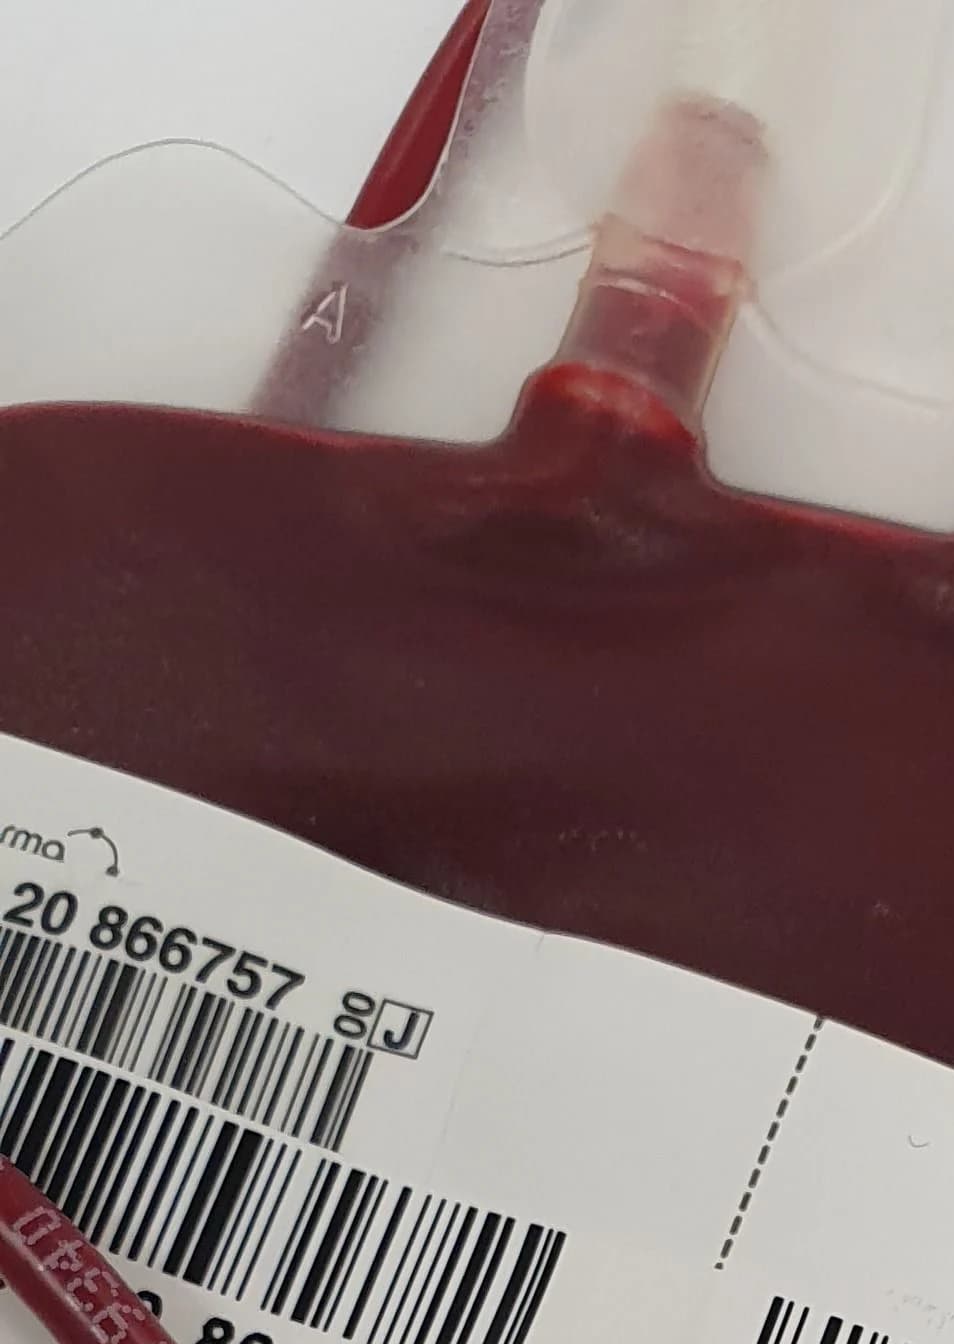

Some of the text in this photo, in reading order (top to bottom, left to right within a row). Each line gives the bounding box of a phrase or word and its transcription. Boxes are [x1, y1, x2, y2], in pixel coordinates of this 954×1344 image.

[301, 283, 349, 343] A
[3, 882, 78, 935] 20
[90, 905, 305, 1009] 866757
